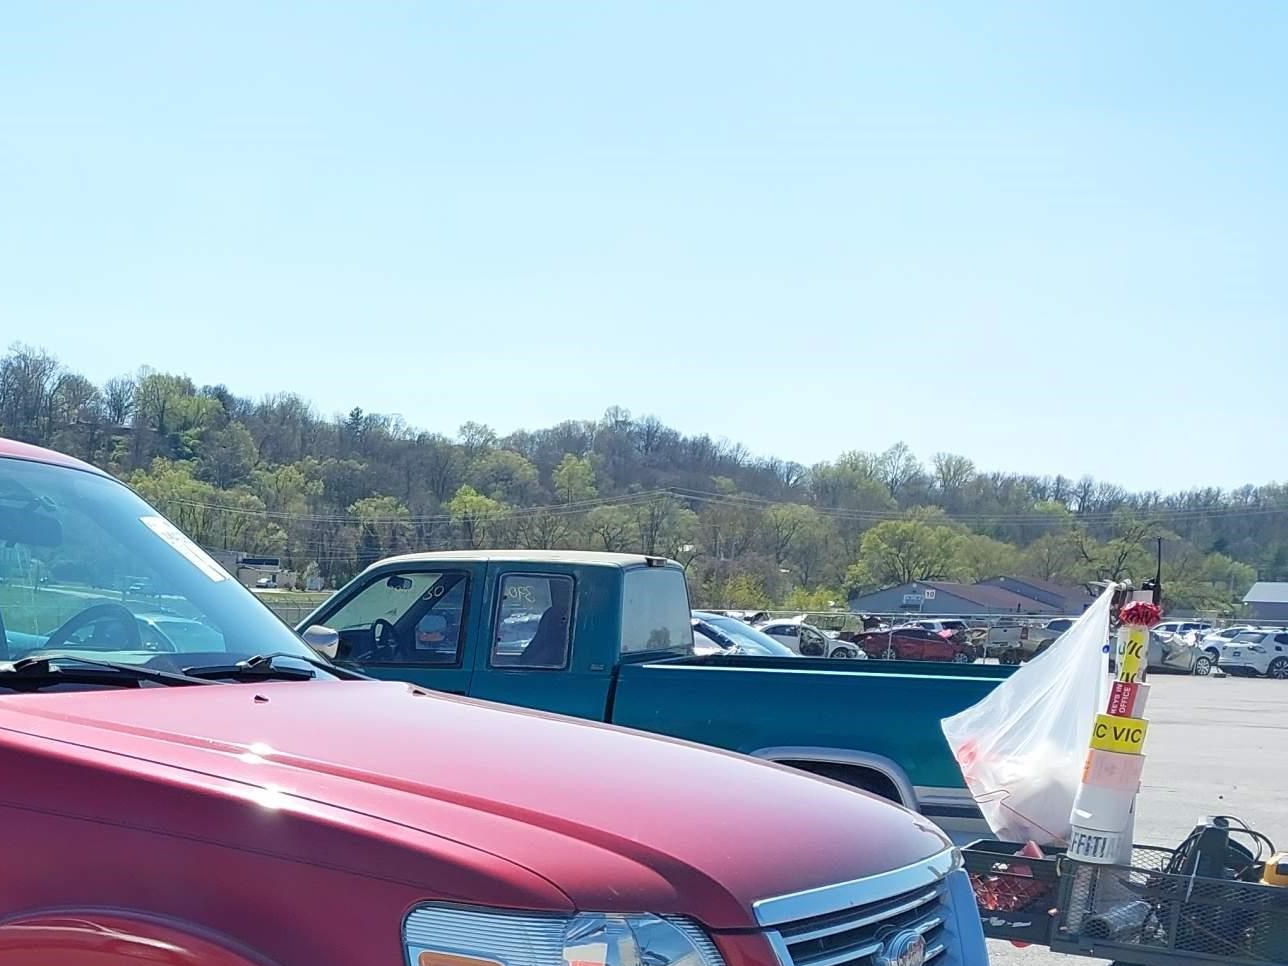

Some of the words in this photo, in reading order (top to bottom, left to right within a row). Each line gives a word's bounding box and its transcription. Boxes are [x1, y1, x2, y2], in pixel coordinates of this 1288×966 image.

[926, 591, 935, 599] 10
[1115, 683, 1123, 693] IN
[1110, 693, 1121, 714] KEYS
[1119, 686, 1131, 713] OFFICE
[1112, 726, 1142, 743] VIC
